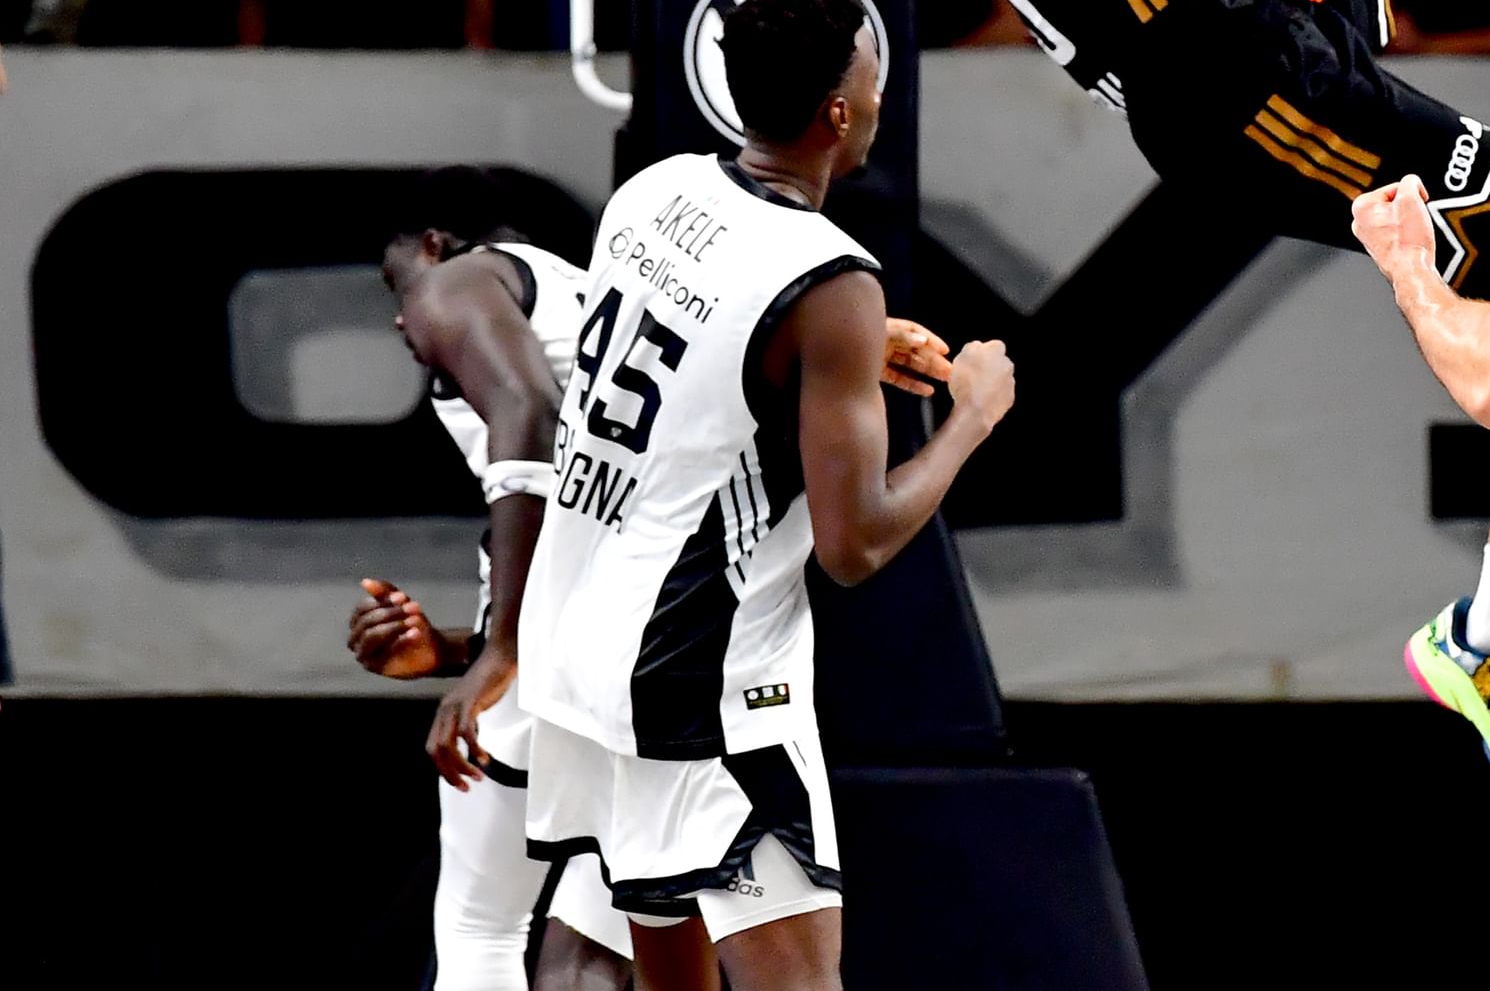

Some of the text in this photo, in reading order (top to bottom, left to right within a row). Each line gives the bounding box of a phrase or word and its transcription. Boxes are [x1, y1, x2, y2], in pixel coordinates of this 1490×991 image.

[650, 195, 727, 262] AKELE
[625, 240, 720, 324] Pelliconi
[576, 286, 689, 455] 45
